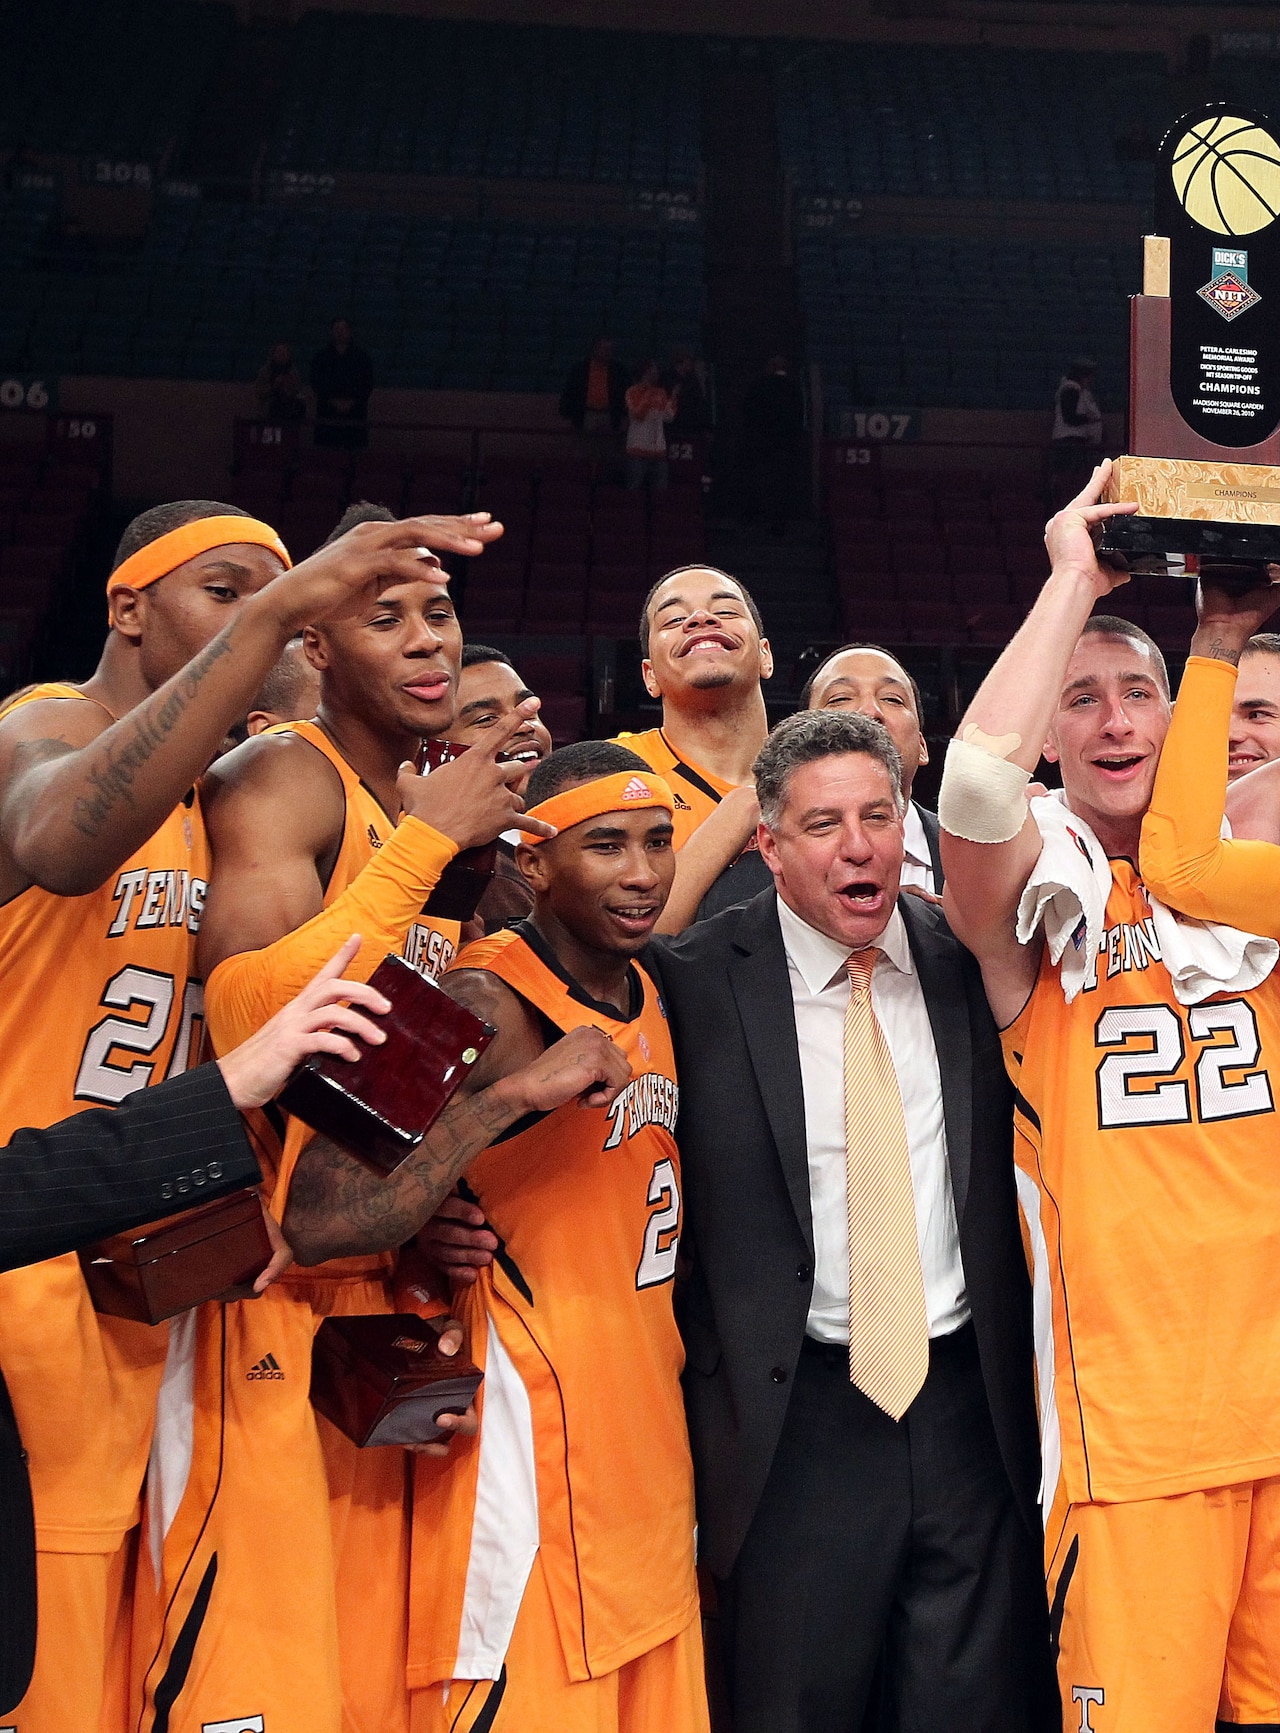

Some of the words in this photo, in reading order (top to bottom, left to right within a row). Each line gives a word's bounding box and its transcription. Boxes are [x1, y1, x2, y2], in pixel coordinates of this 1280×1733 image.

[1215, 252, 1246, 265] DICK'S
[1214, 289, 1246, 302] NIT
[1202, 353, 1233, 362] MEMORIAL
[1199, 382, 1261, 395] CHAMPIONS
[1192, 399, 1219, 407] MADISON
[1219, 401, 1241, 409] SQUARE
[1241, 403, 1265, 411] GARDEN
[1202, 407, 1233, 416] NOVEMBER
[854, 412, 912, 440] 107
[845, 447, 871, 466] 53
[1214, 489, 1258, 499] CHAMPIONS
[622, 788, 653, 801] adidas
[1094, 997, 1276, 1130] 22
[635, 1156, 680, 1292] 2
[246, 1369, 285, 1381] adidas
[1072, 1685, 1105, 1733] T
